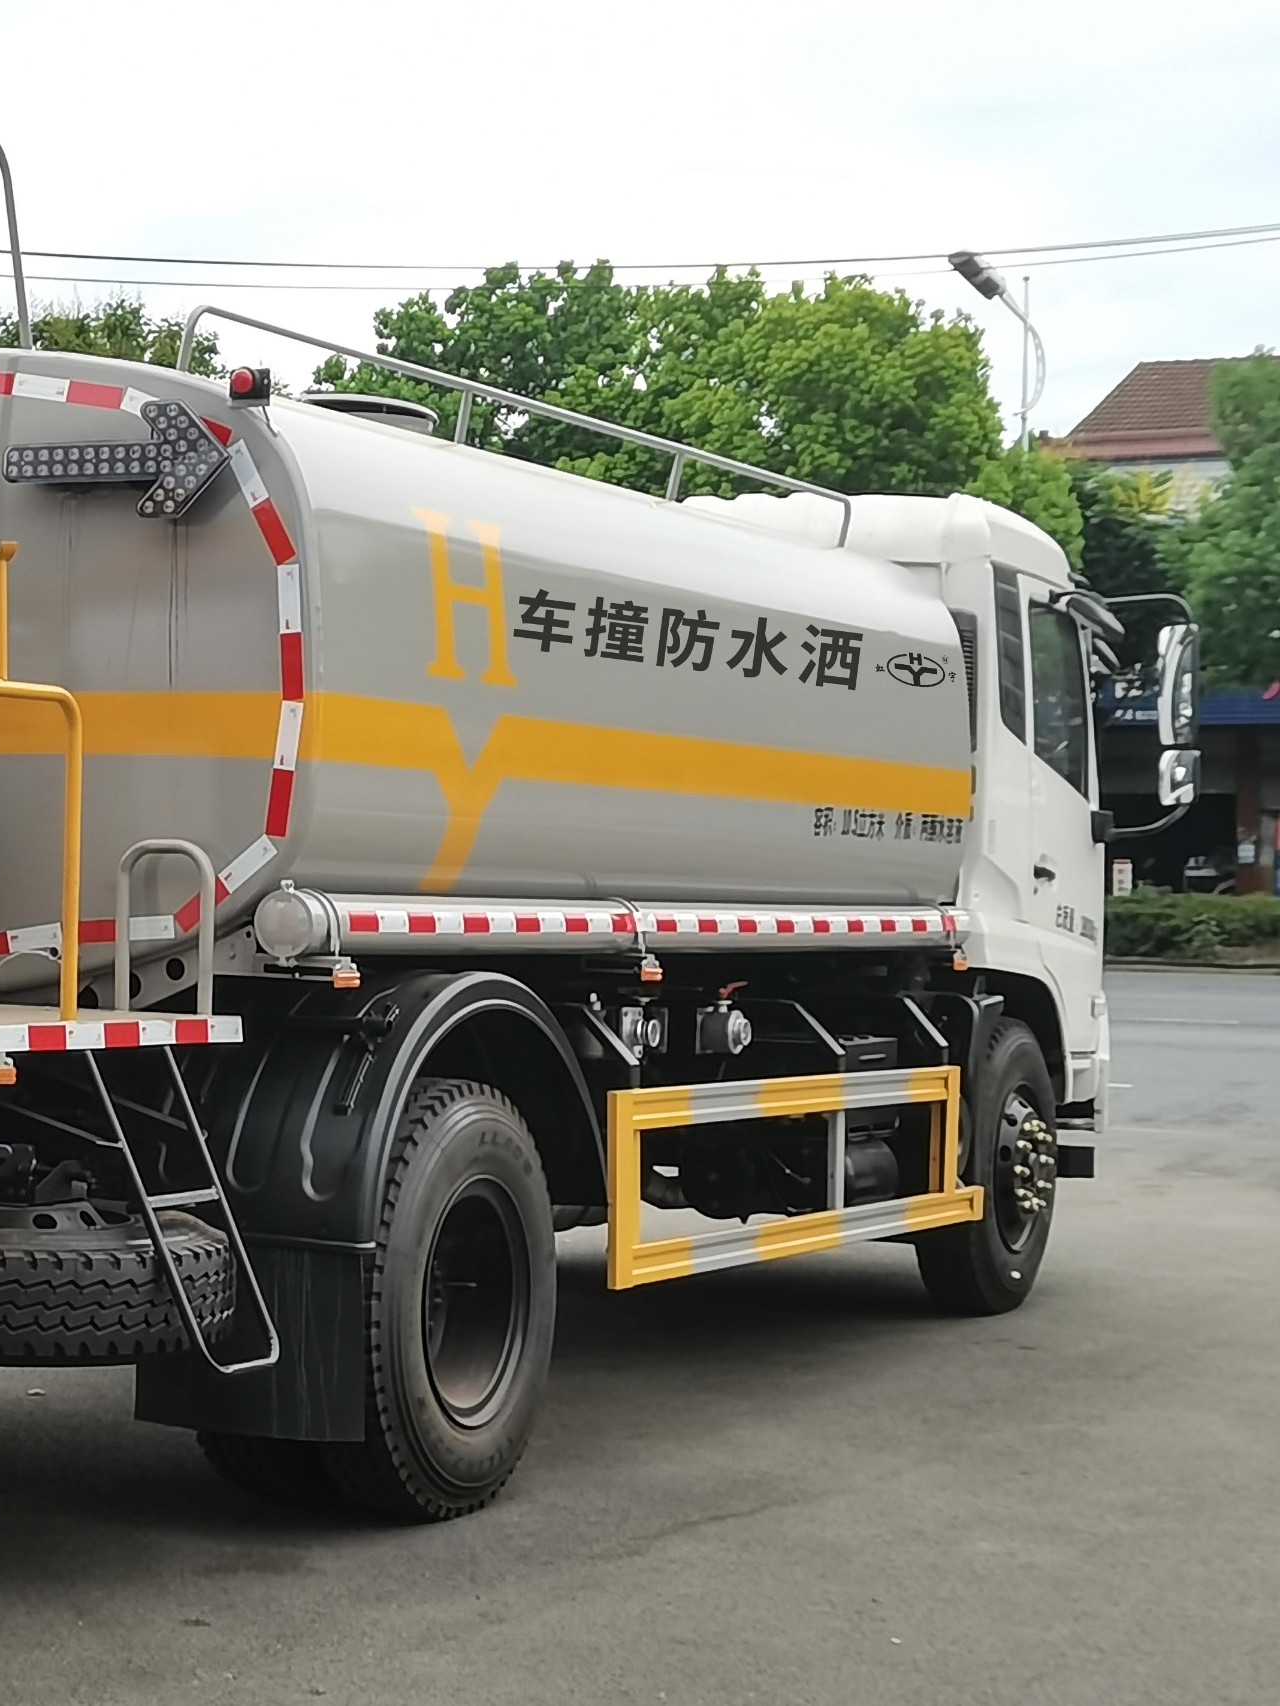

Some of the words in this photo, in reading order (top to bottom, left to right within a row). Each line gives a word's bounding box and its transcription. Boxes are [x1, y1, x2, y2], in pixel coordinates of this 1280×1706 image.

[513, 588, 864, 691] 车撞防水洒
